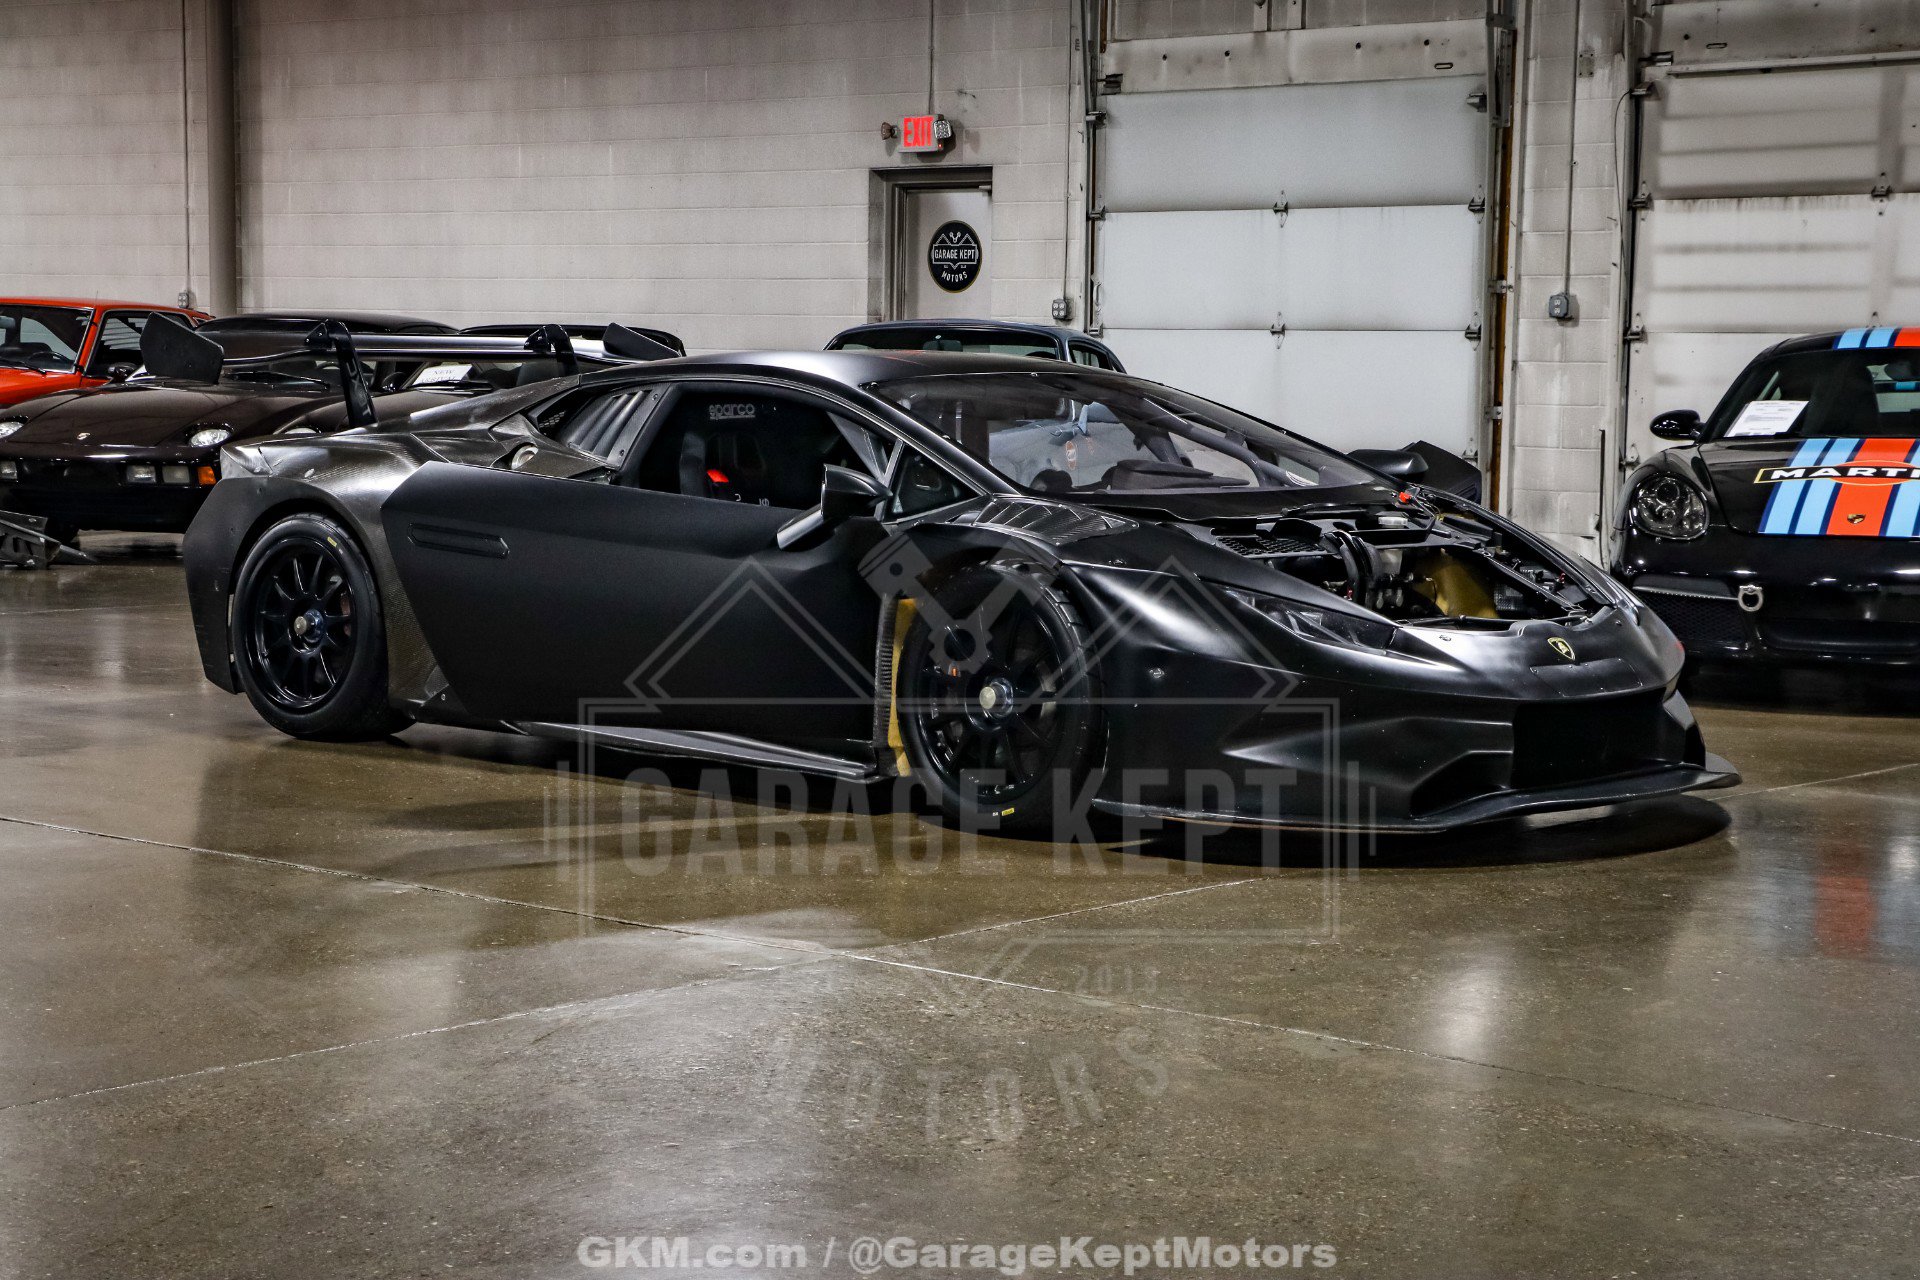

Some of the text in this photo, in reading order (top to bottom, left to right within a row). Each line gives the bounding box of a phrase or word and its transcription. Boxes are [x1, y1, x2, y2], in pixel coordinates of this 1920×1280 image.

[903, 116, 934, 148] EXIT
[934, 249, 976, 259] GARAGE KEPT
[941, 270, 968, 283] MOTORS
[708, 403, 755, 420] sparco
